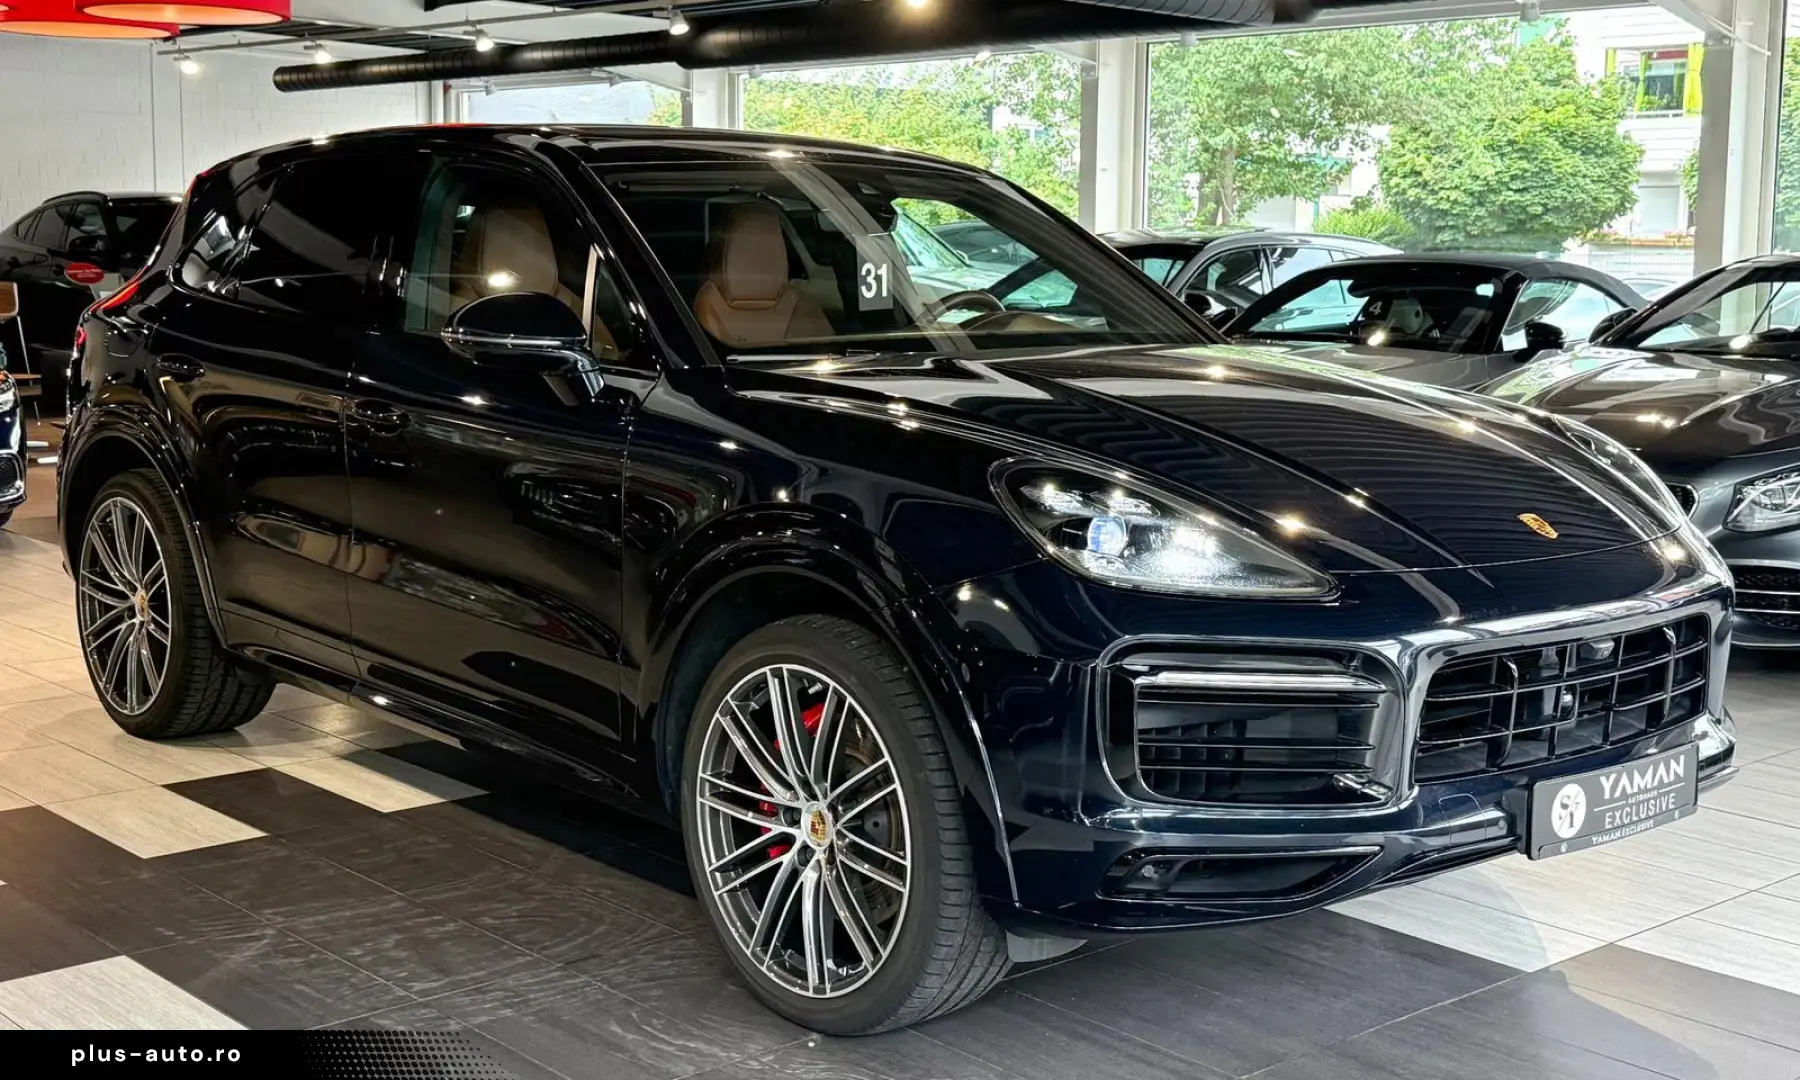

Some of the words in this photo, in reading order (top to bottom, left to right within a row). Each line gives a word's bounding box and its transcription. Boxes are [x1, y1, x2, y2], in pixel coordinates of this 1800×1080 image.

[861, 262, 888, 298] 31
[1369, 301, 1383, 316] 4
[1600, 754, 1685, 800] YAMAN
[1604, 792, 1676, 829] EXCLUSIVE
[1592, 830, 1621, 845] YAMAN
[1622, 819, 1655, 837] EXCLUSIVE
